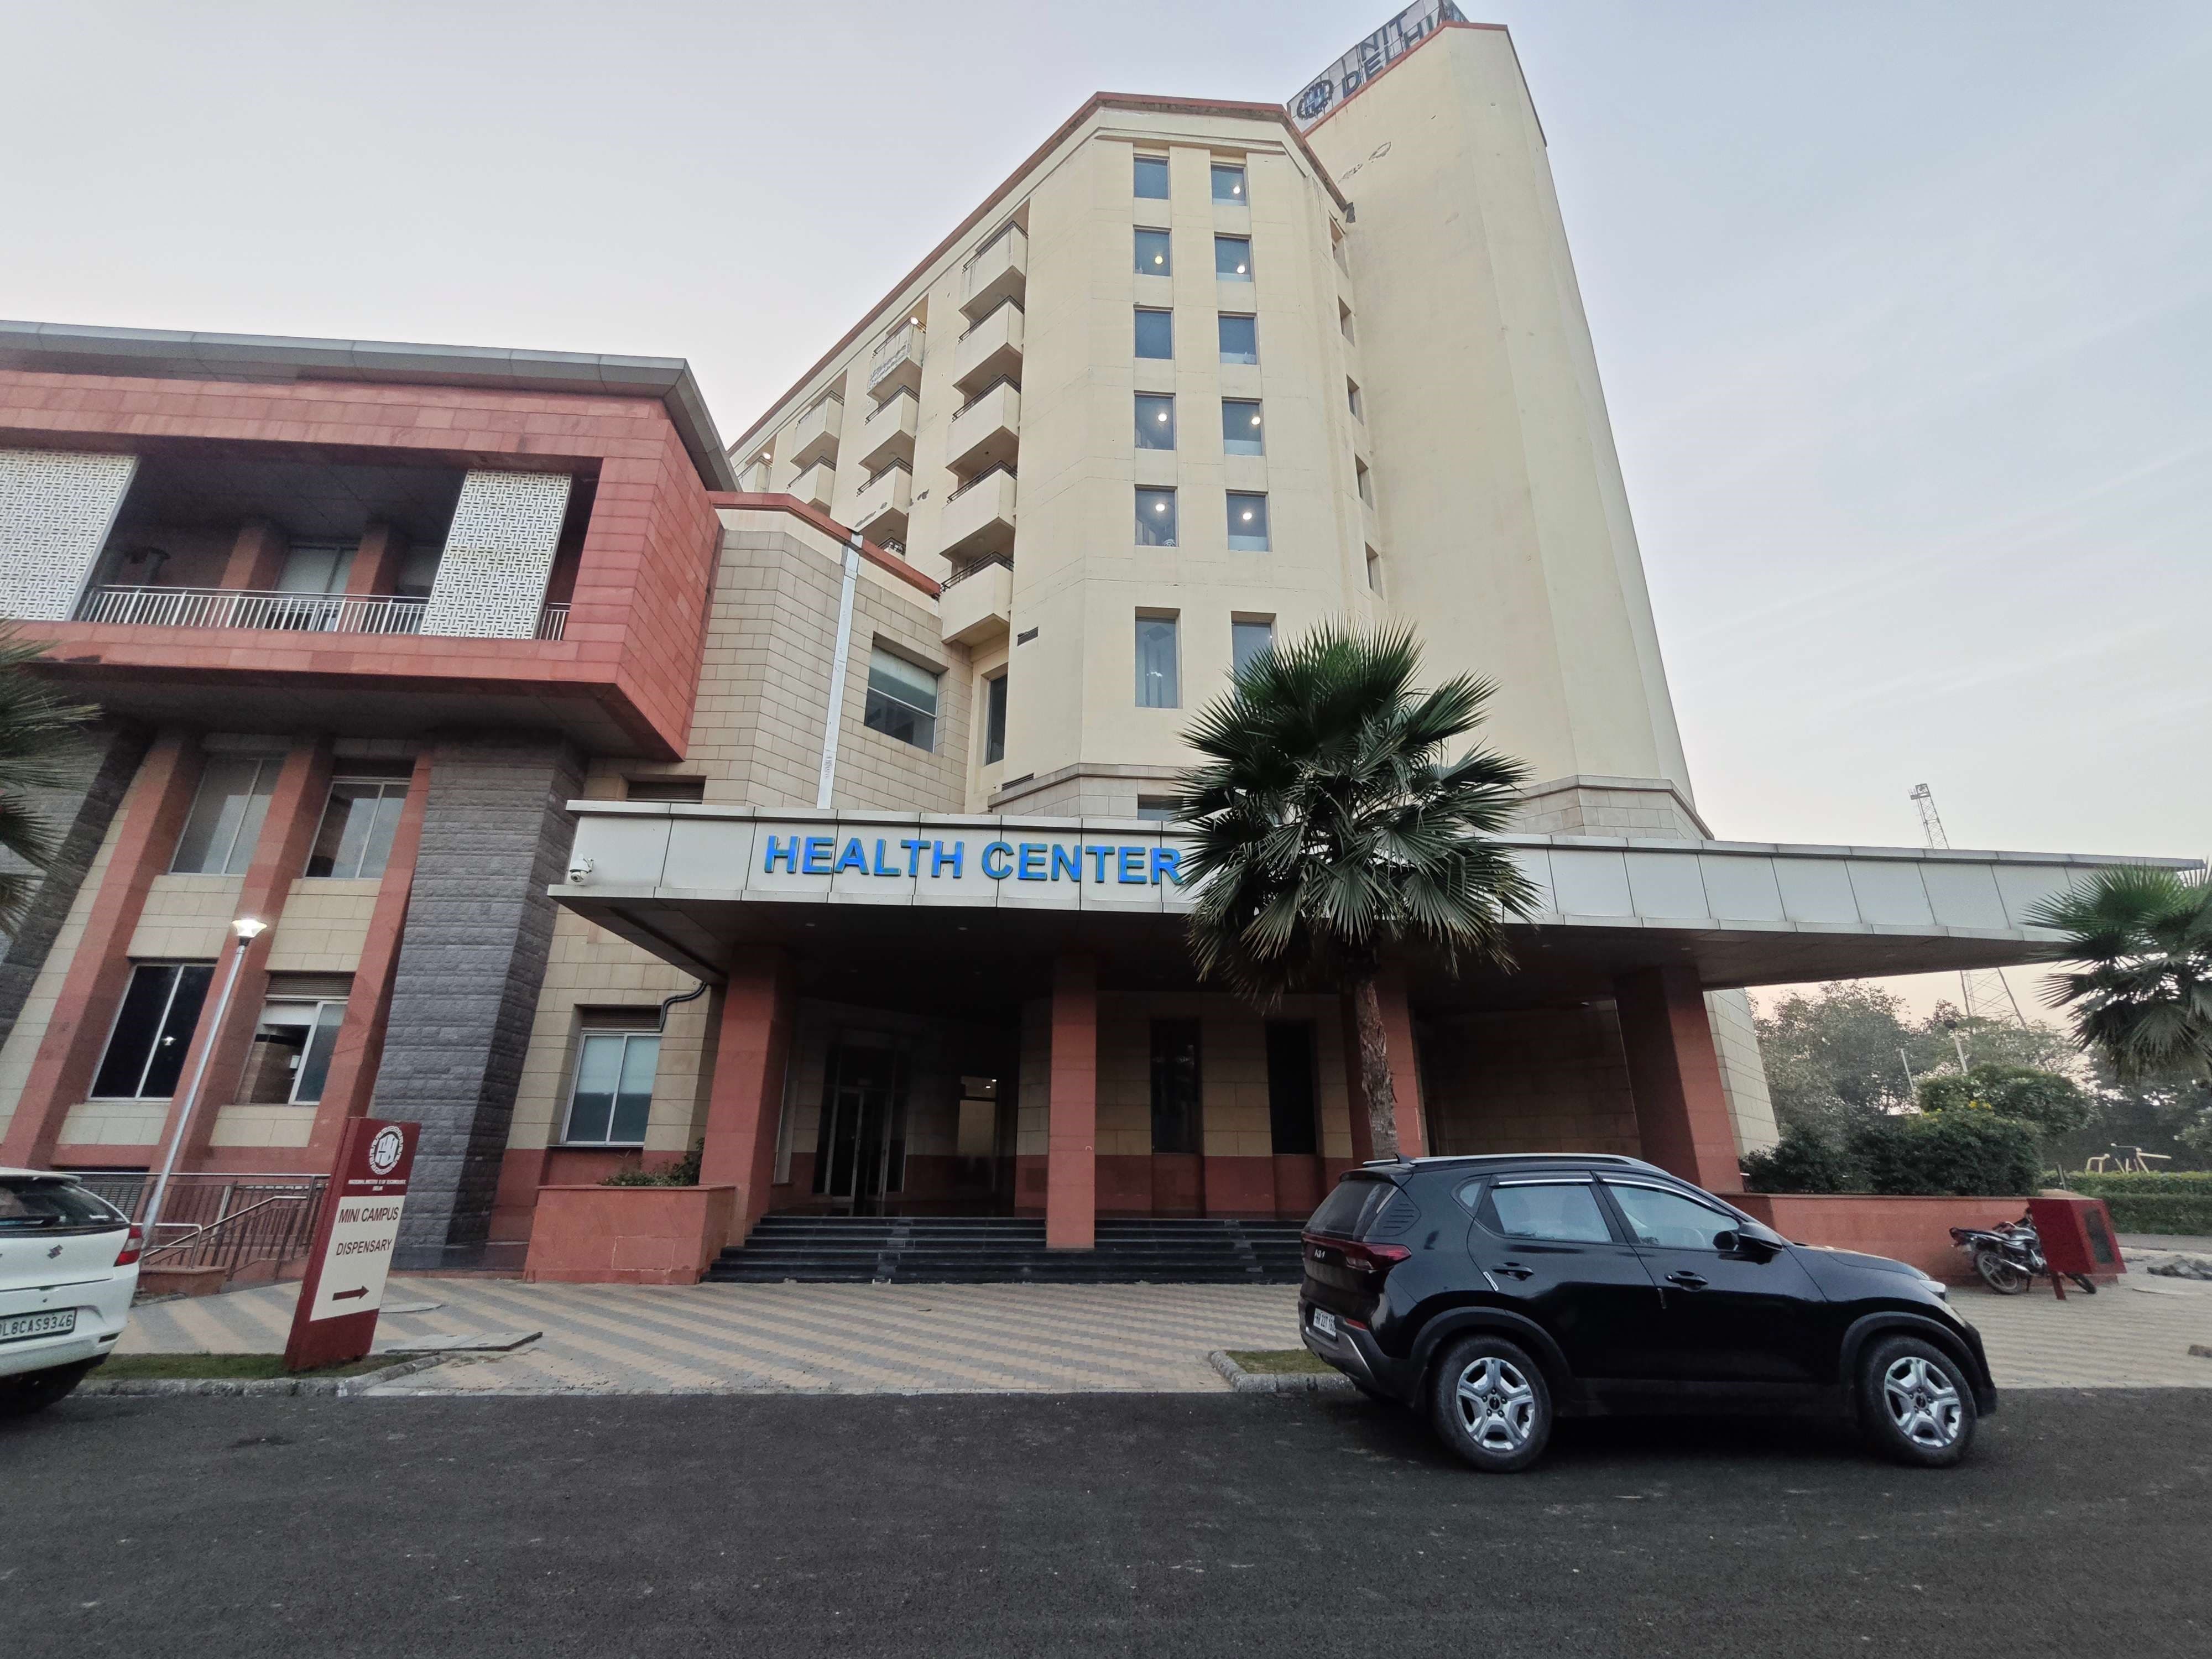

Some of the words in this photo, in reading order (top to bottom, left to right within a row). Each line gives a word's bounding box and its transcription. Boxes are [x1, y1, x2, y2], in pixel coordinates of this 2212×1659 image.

[1359, 11, 1407, 61] NIT
[1342, 14, 1434, 98] DELHI
[764, 835, 964, 878] HEALTH
[982, 841, 1184, 885] CENTER
[338, 1209, 360, 1223] MINI
[362, 1207, 399, 1222] CAMPUS
[336, 1239, 393, 1255] DISPENSARY
[0, 1314, 72, 1337] L8CAS9346
